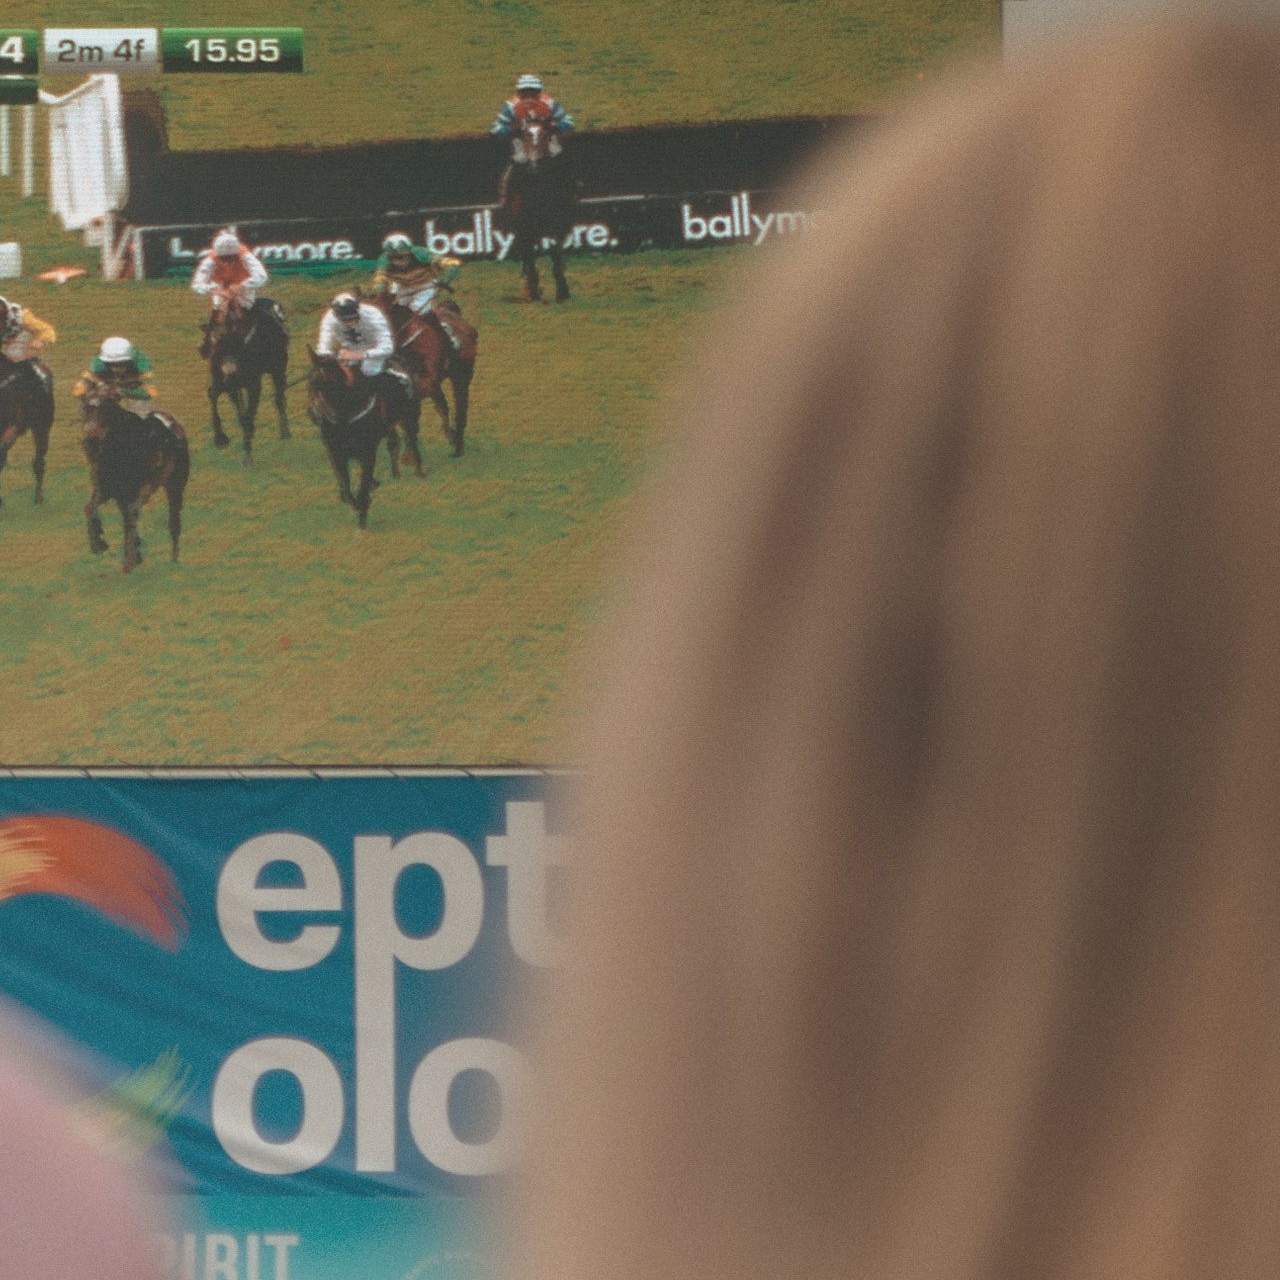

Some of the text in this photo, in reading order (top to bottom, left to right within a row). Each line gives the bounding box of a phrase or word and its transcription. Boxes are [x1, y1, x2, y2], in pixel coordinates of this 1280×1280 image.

[57, 38, 145, 63] 2m 4f
[184, 38, 281, 63] 15.95
